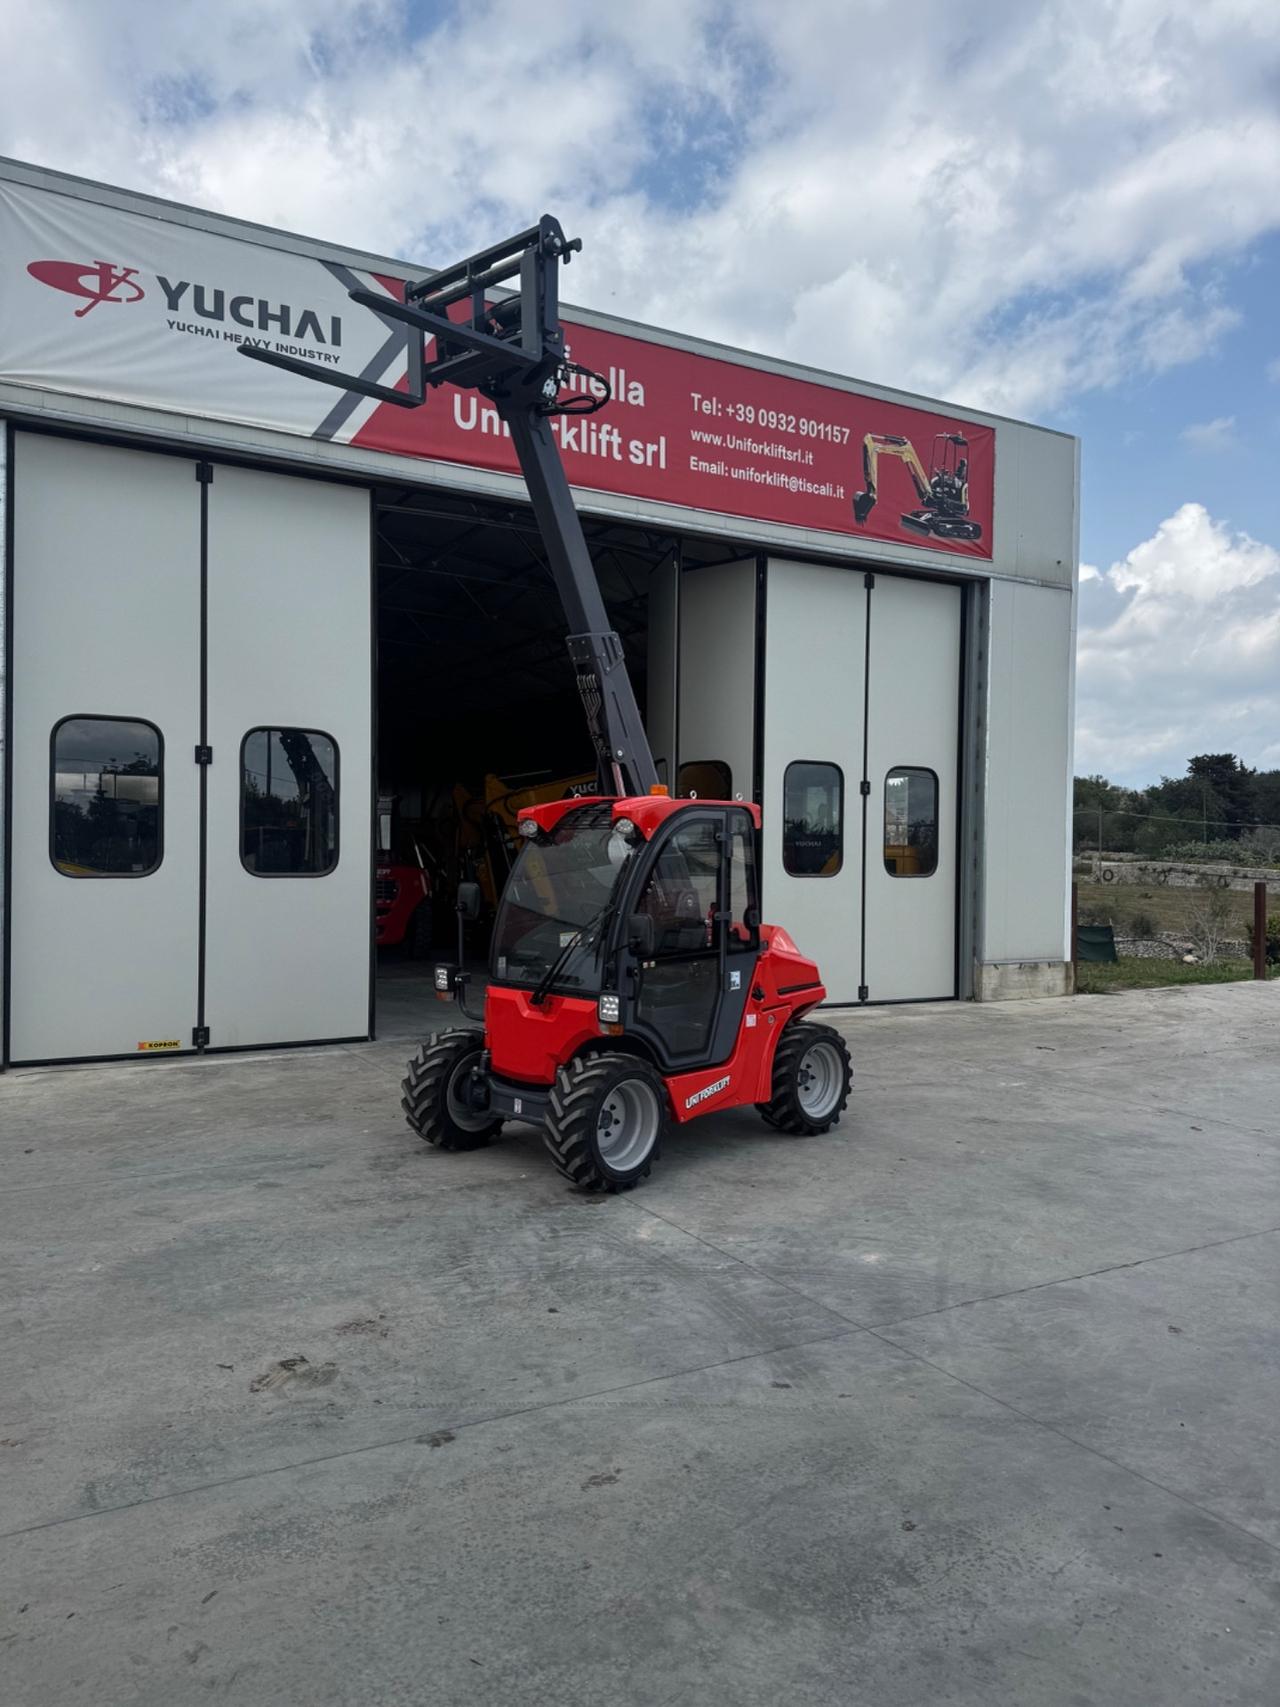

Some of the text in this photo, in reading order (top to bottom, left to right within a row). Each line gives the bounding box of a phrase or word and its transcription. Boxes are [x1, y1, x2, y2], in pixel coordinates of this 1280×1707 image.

[156, 275, 342, 347] YUCHAI
[167, 319, 341, 364] YUCHAI HEAVY INDUSTRY
[690, 392, 850, 445] Tel: +39 0932 901157
[629, 436, 666, 469] srl
[690, 429, 814, 465] www.Uniforkliftsrl.it
[689, 455, 845, 499] Email: uniforklift@tiscali.it
